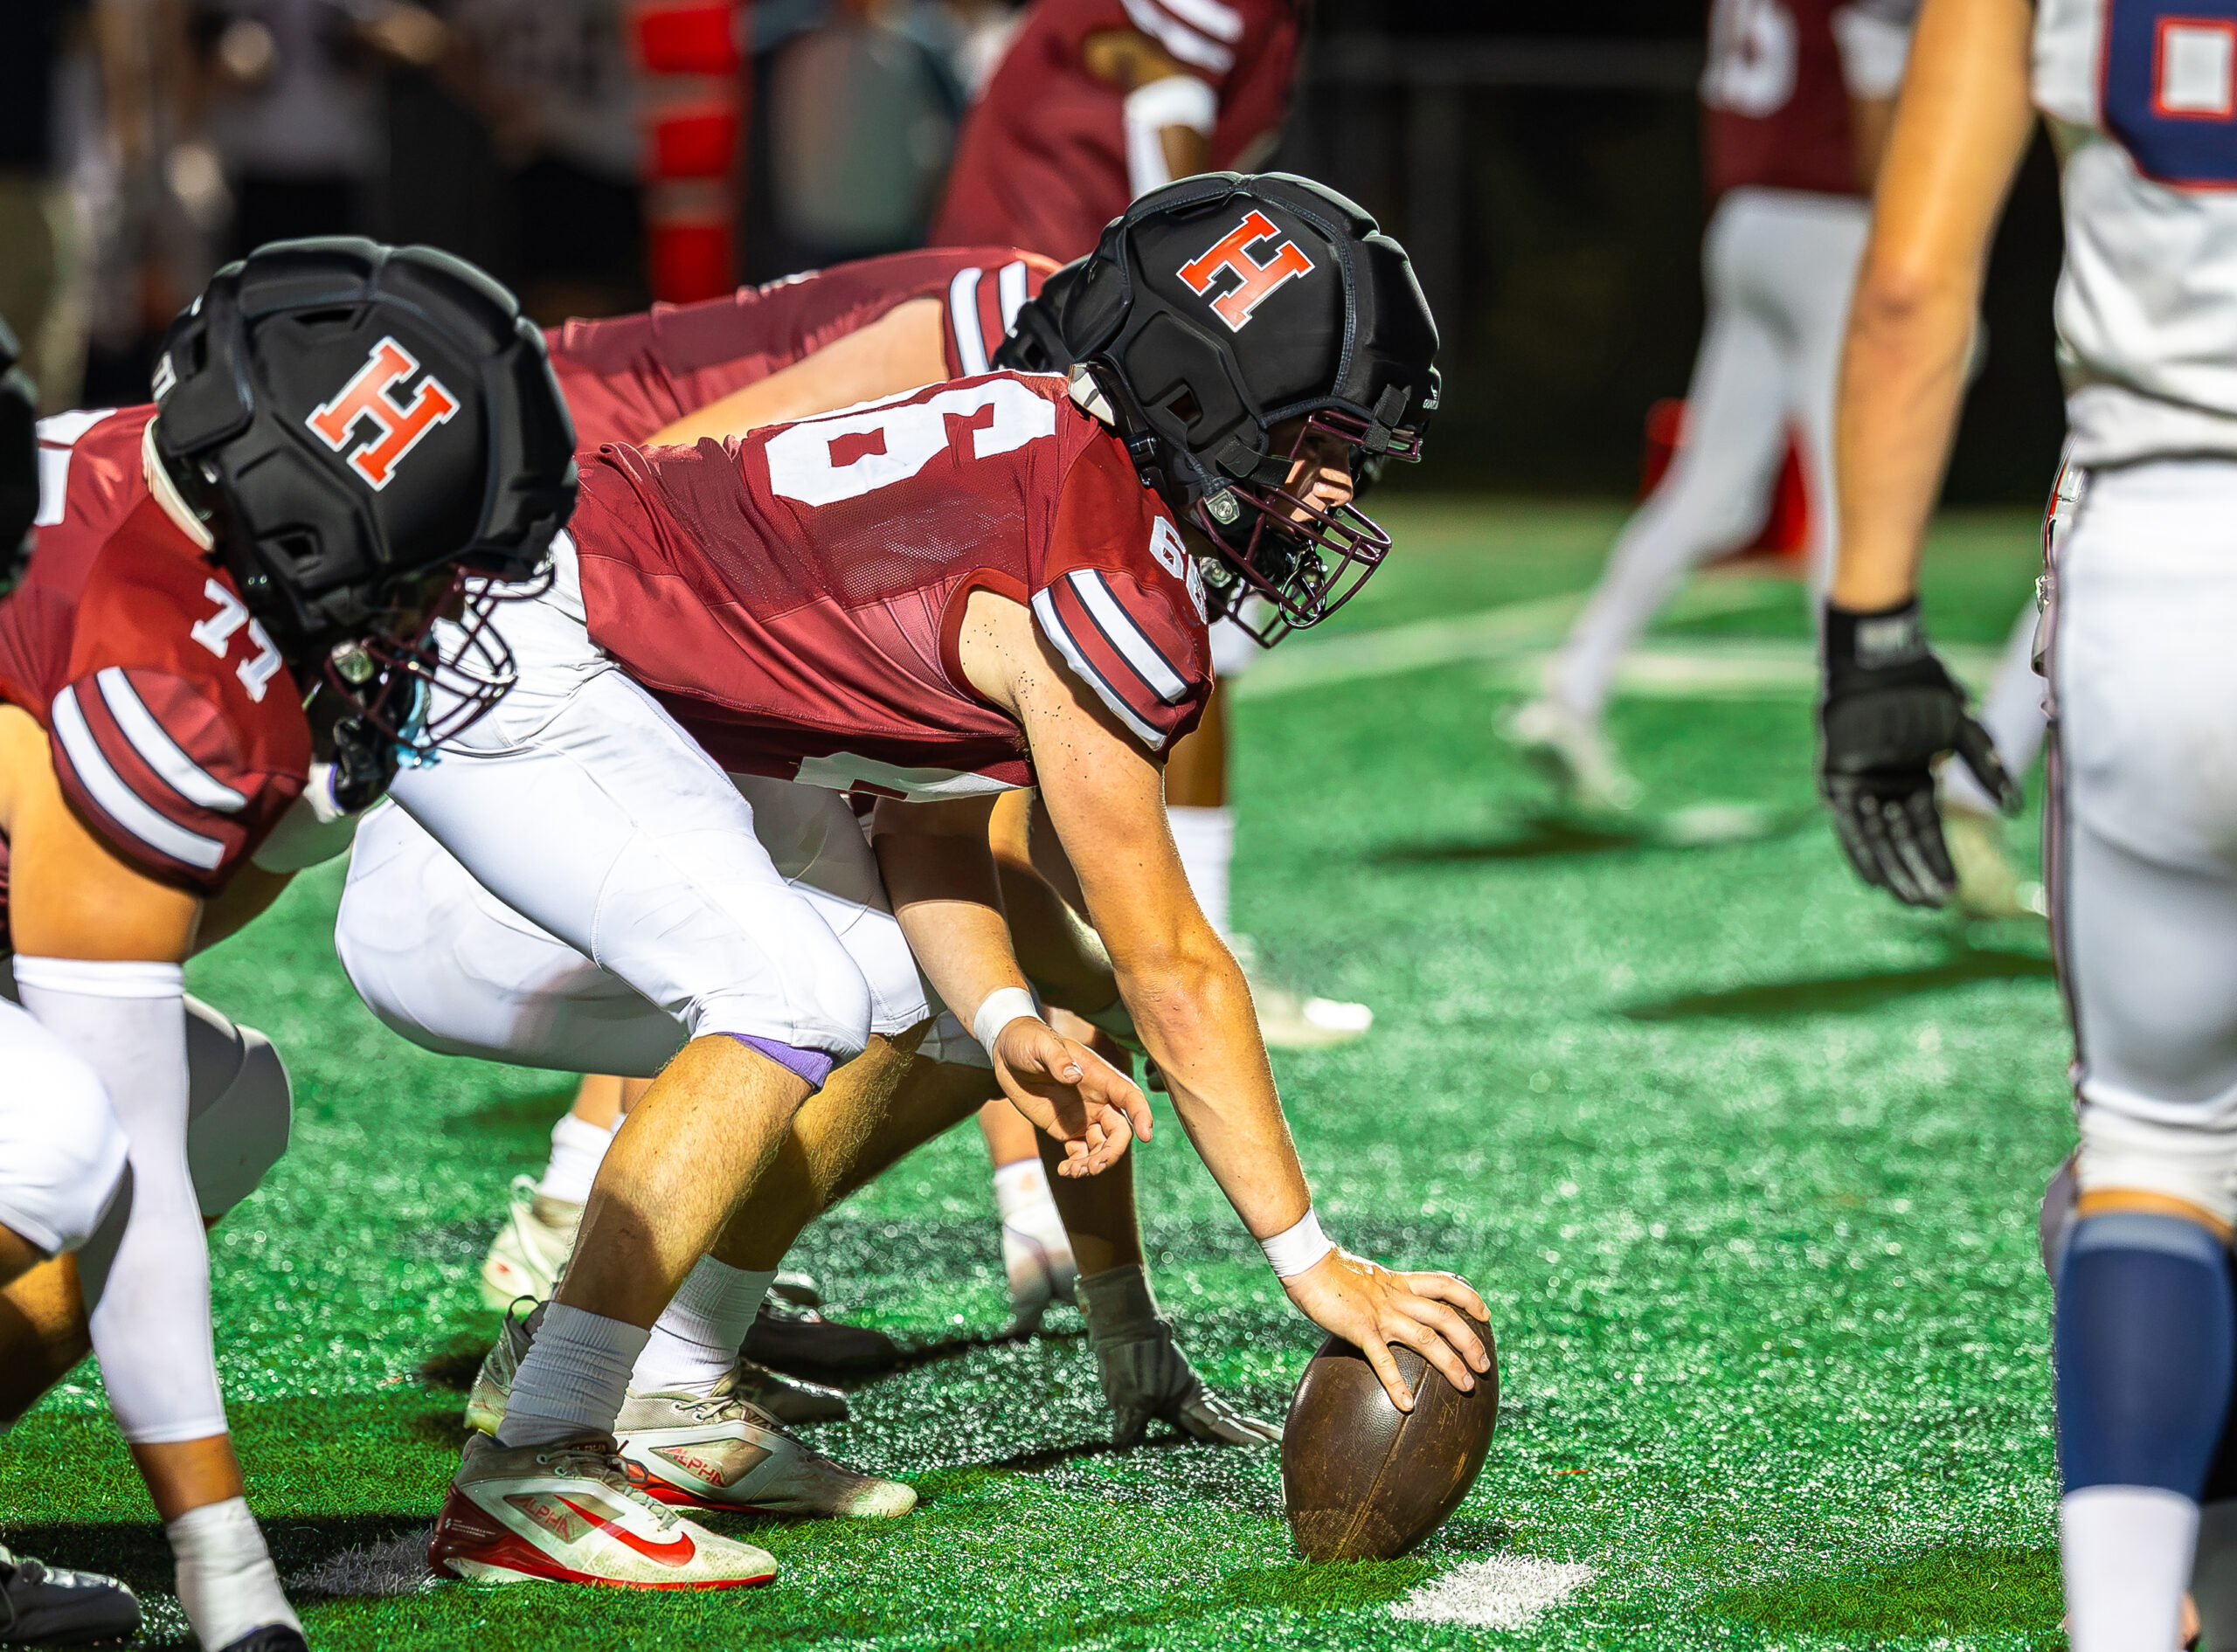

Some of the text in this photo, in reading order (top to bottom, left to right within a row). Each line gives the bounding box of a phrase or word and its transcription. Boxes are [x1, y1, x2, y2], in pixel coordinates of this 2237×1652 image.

[1176, 210, 1315, 333] H
[306, 335, 461, 491] H
[190, 577, 283, 703] 77
[510, 1496, 571, 1540] ALPHA
[663, 1448, 724, 1488] ALPHA
